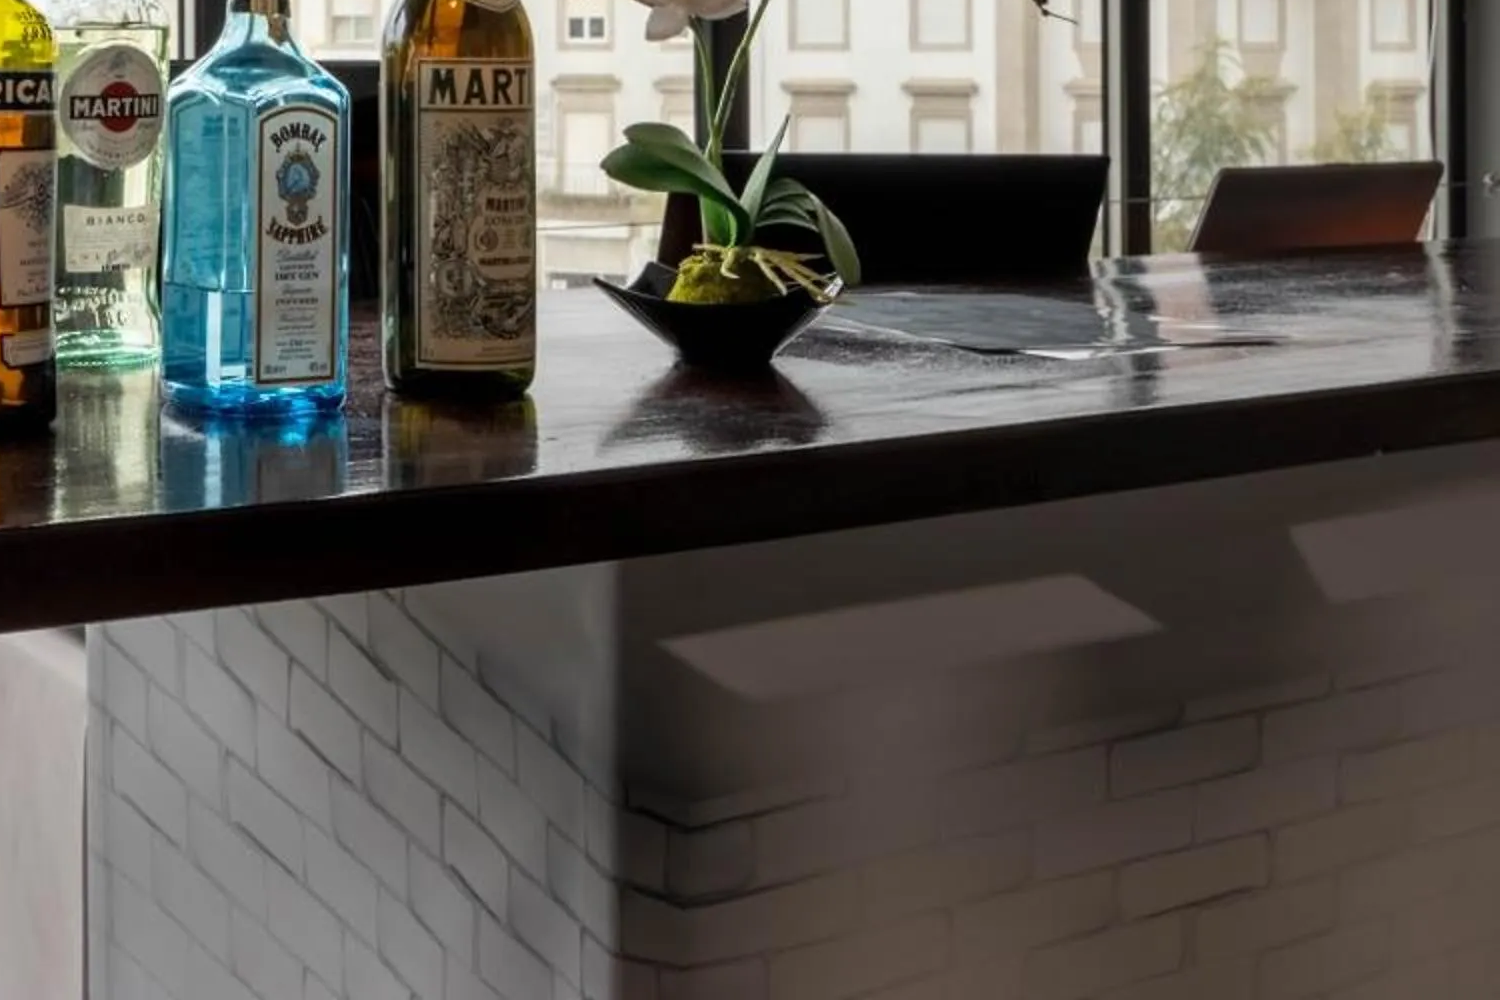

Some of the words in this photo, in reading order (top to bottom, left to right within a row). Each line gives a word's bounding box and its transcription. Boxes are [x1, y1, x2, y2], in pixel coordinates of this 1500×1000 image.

[73, 96, 158, 118] MARTINI
[270, 122, 326, 153] BOMBAY
[86, 213, 145, 227] BIANCO
[266, 215, 329, 245] SAPPHIRE
